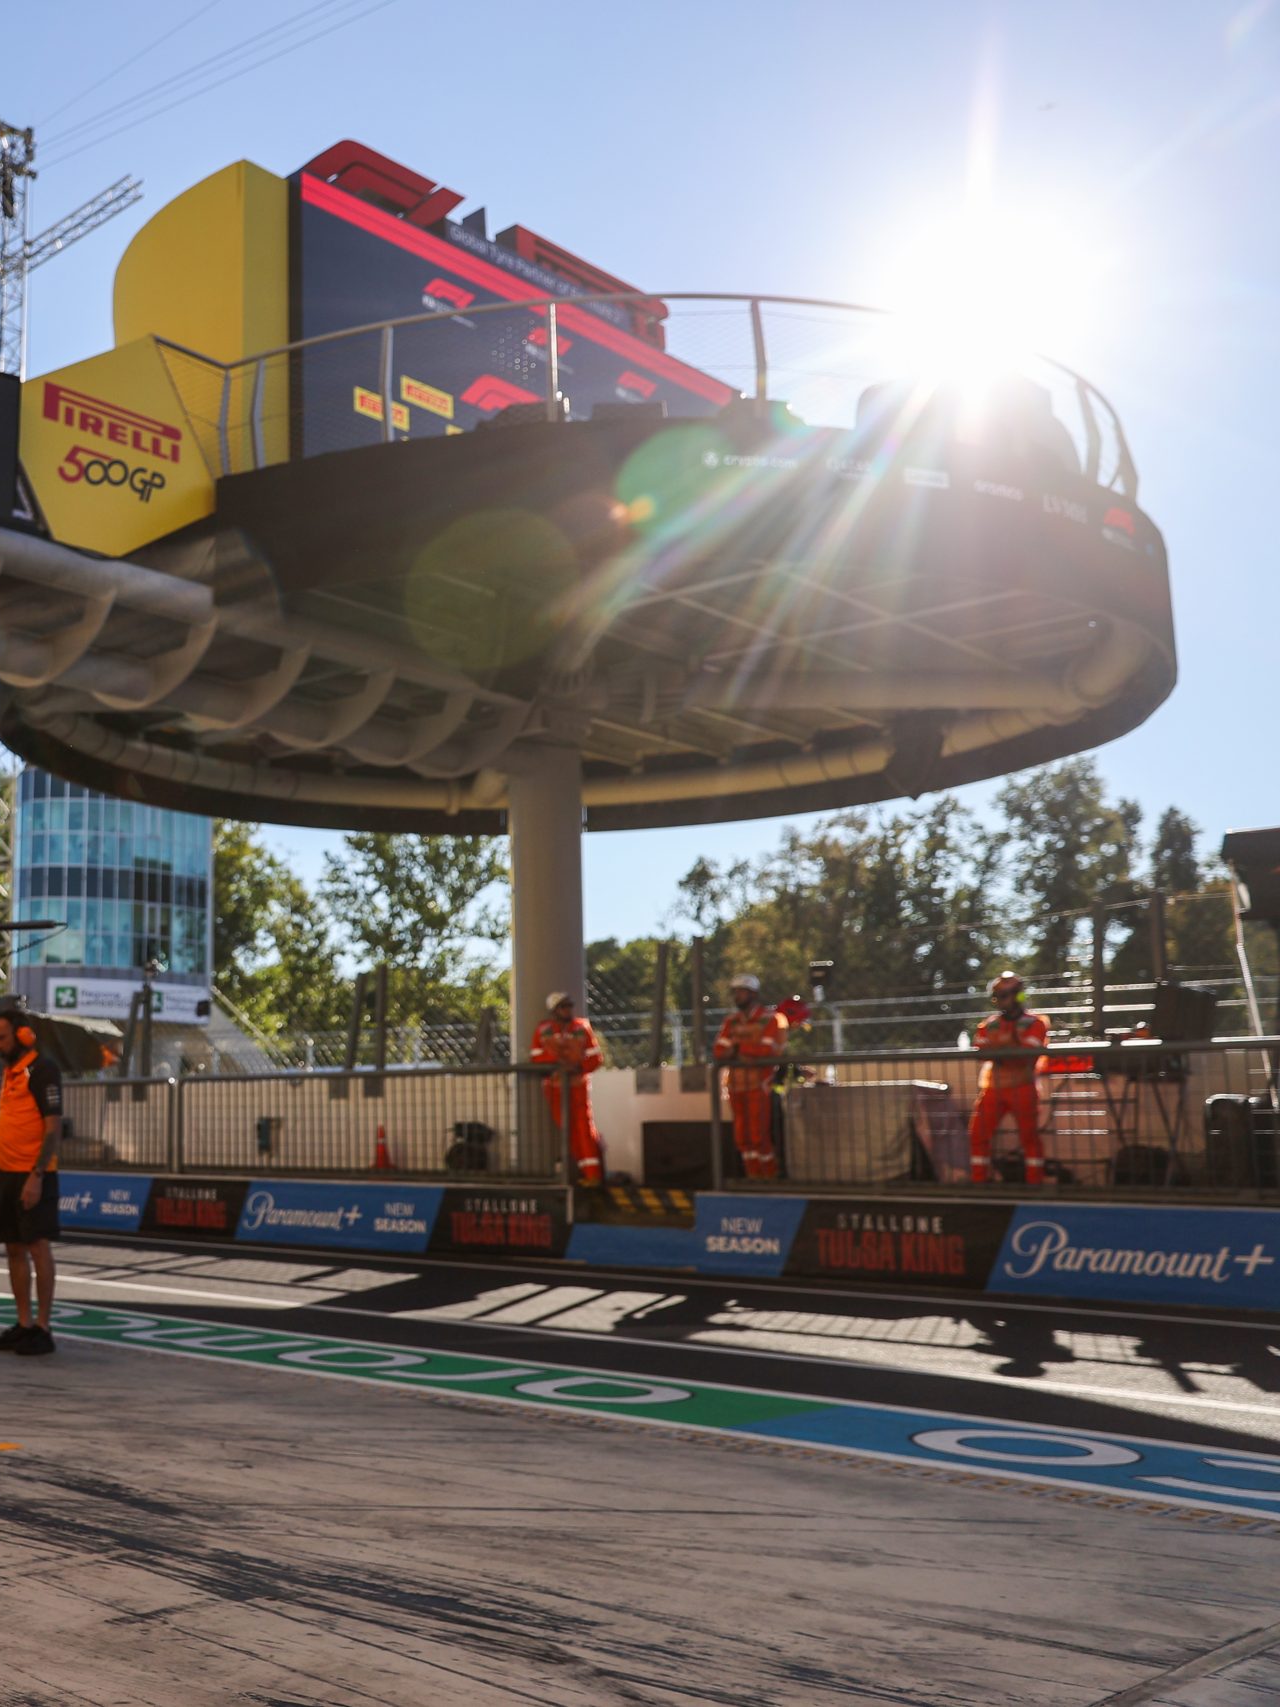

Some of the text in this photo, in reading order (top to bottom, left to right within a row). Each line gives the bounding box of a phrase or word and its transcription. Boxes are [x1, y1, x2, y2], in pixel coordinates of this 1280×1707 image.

[43, 381, 182, 464] PIRELLI
[101, 1202, 139, 1215] SEASON
[243, 1191, 362, 1231] Paramount+
[384, 1203, 415, 1217] NEW
[465, 1198, 538, 1214] STALLONE
[373, 1217, 427, 1233] SEASON
[721, 1216, 763, 1234] NEW
[837, 1213, 944, 1234] STALLONE
[705, 1235, 781, 1254] SEASON
[815, 1228, 965, 1275] TULSA KING
[1003, 1219, 1275, 1283] Paramount+
